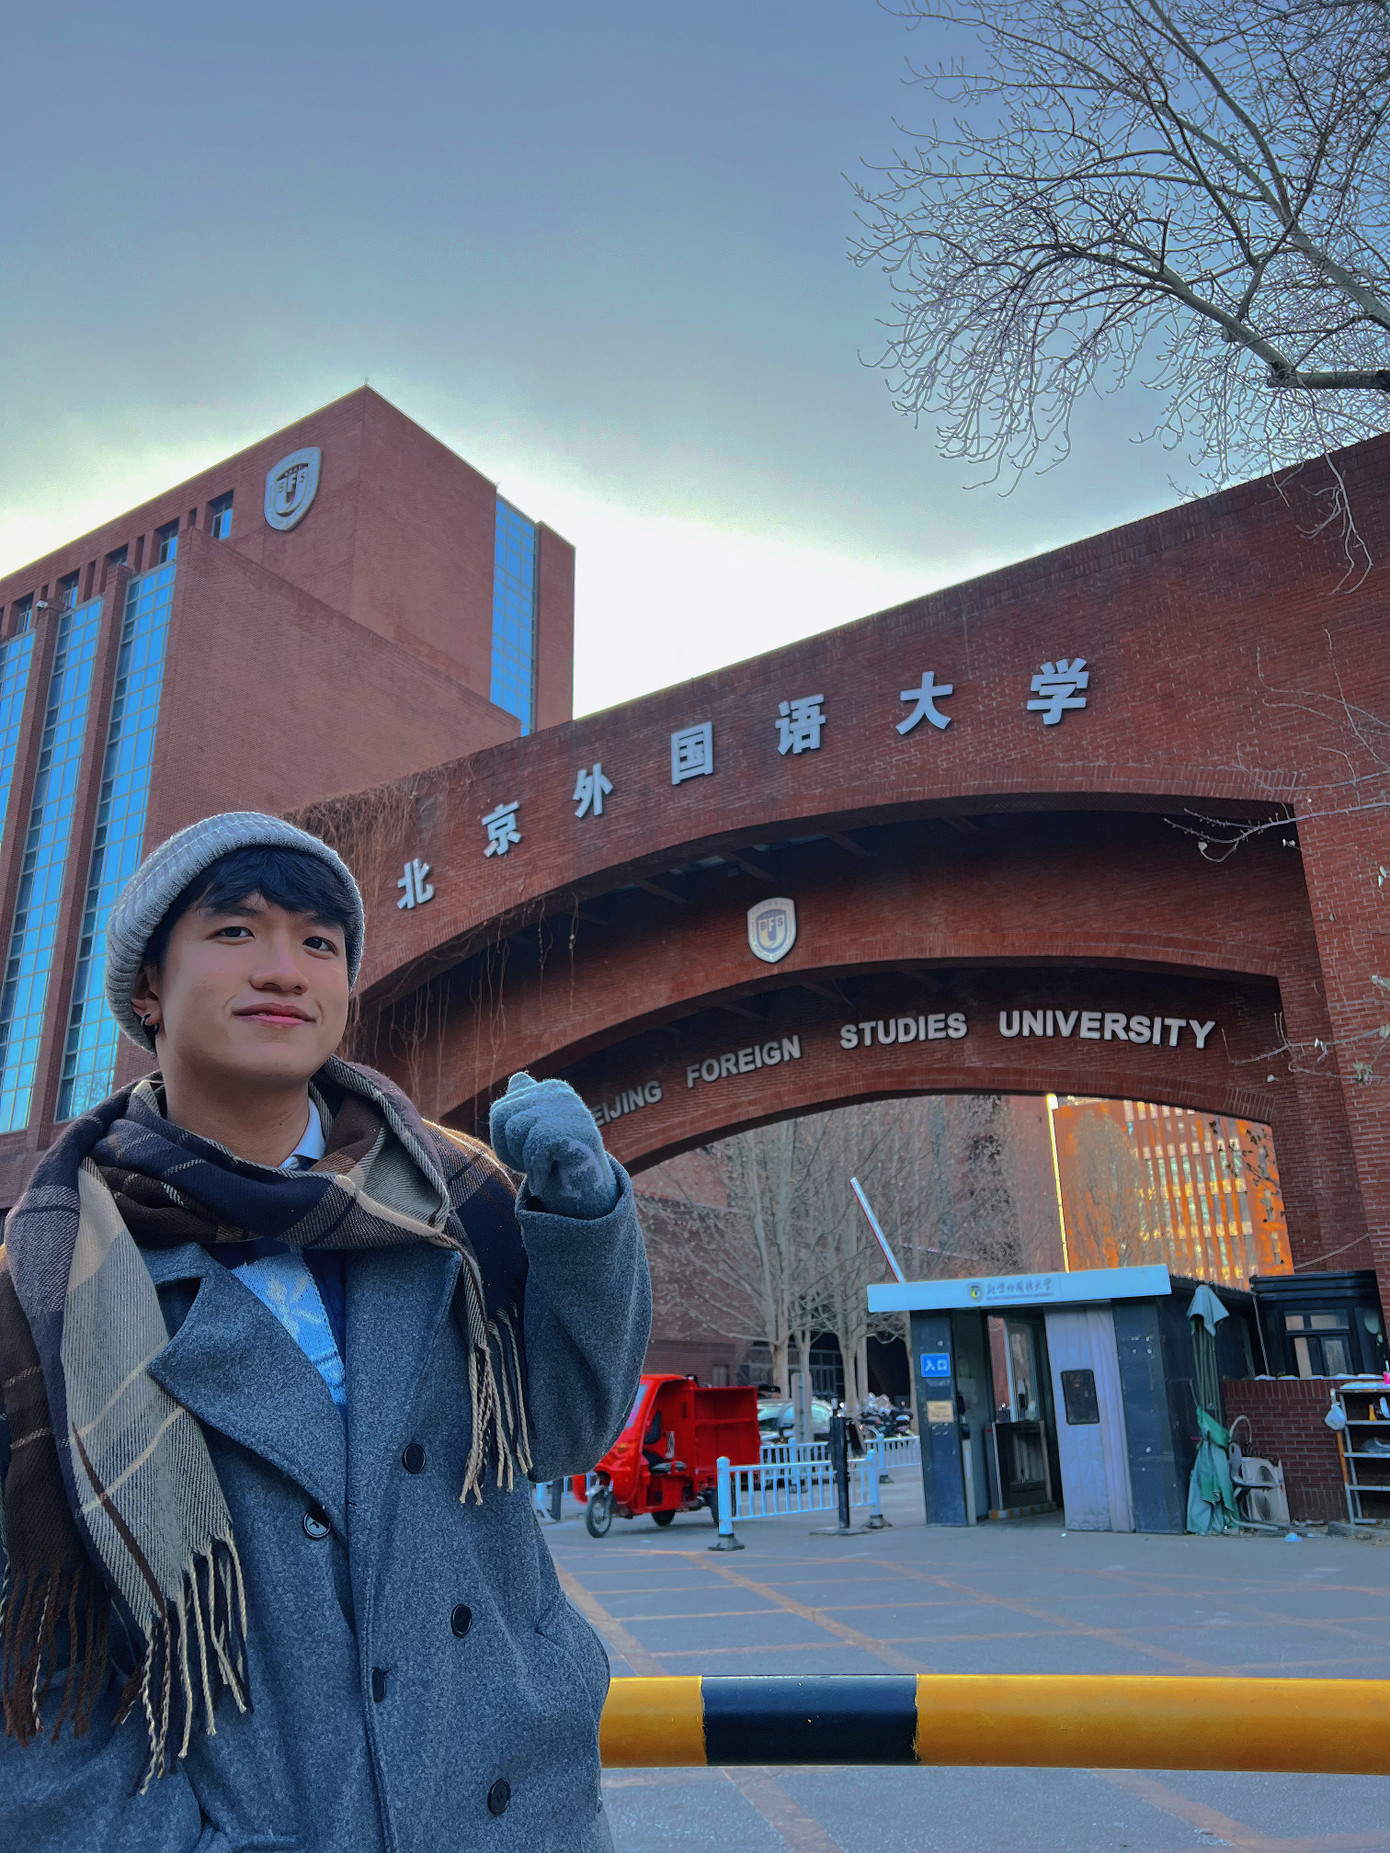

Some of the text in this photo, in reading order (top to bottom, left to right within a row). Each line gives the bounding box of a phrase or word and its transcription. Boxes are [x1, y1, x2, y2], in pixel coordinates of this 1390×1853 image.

[395, 657, 1090, 910] 北京外国语大学
[590, 1008, 1217, 1127] EIJING FOREIGN STUDIES UNIVERSITY
[924, 1358, 948, 1372] 入口
